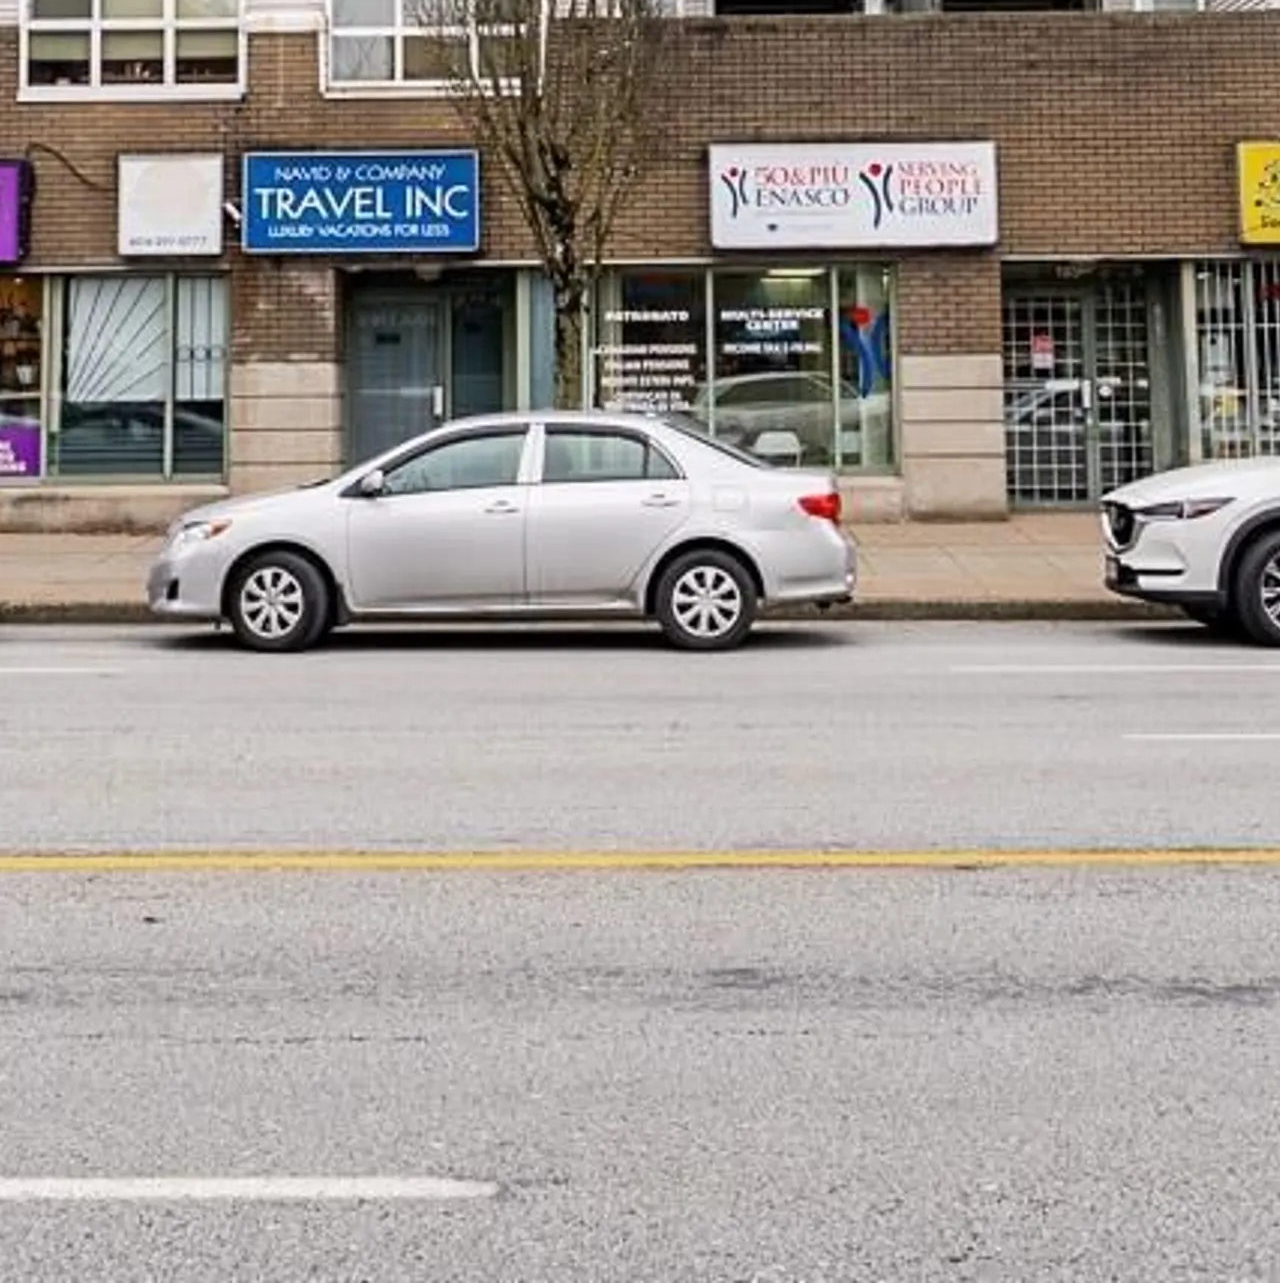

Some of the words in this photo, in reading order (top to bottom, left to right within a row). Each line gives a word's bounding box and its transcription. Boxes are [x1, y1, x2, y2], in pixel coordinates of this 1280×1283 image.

[274, 166, 332, 181] NAVID
[335, 166, 352, 181] &
[355, 164, 447, 181] COMPANY
[897, 161, 980, 177] SERVING
[900, 178, 983, 196] PEOPLE
[254, 186, 392, 220] TRAVEL
[405, 184, 470, 219] INC
[756, 188, 850, 208] ENASCO
[899, 197, 980, 216] GROUP
[268, 224, 314, 237] LUXURY
[317, 224, 392, 237] VACATIONS
[394, 224, 419, 236] FOR
[421, 223, 451, 237] LESS
[745, 319, 799, 332] CENTER
